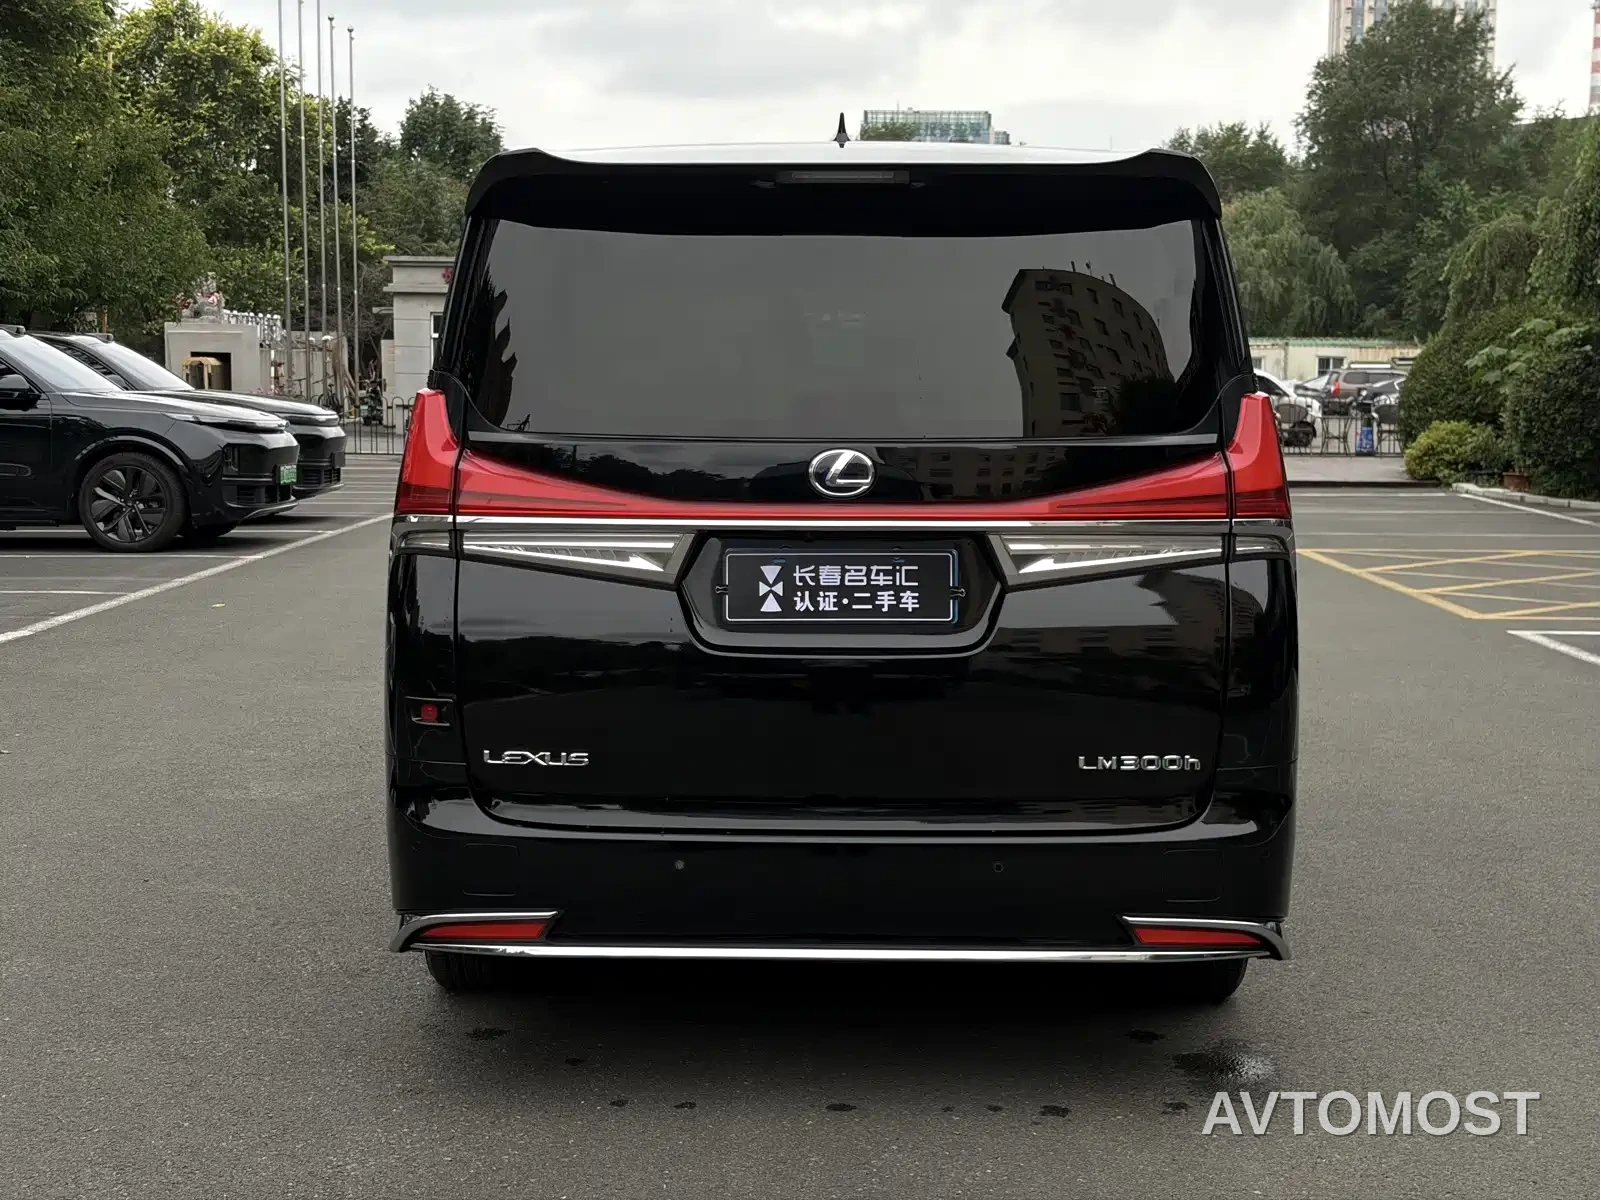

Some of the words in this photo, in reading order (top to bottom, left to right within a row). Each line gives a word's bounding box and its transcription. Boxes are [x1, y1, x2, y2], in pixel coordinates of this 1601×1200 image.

[793, 564, 919, 587] 长春名车汇
[483, 749, 589, 766] LEXUS
[1078, 755, 1201, 771] LM300h
